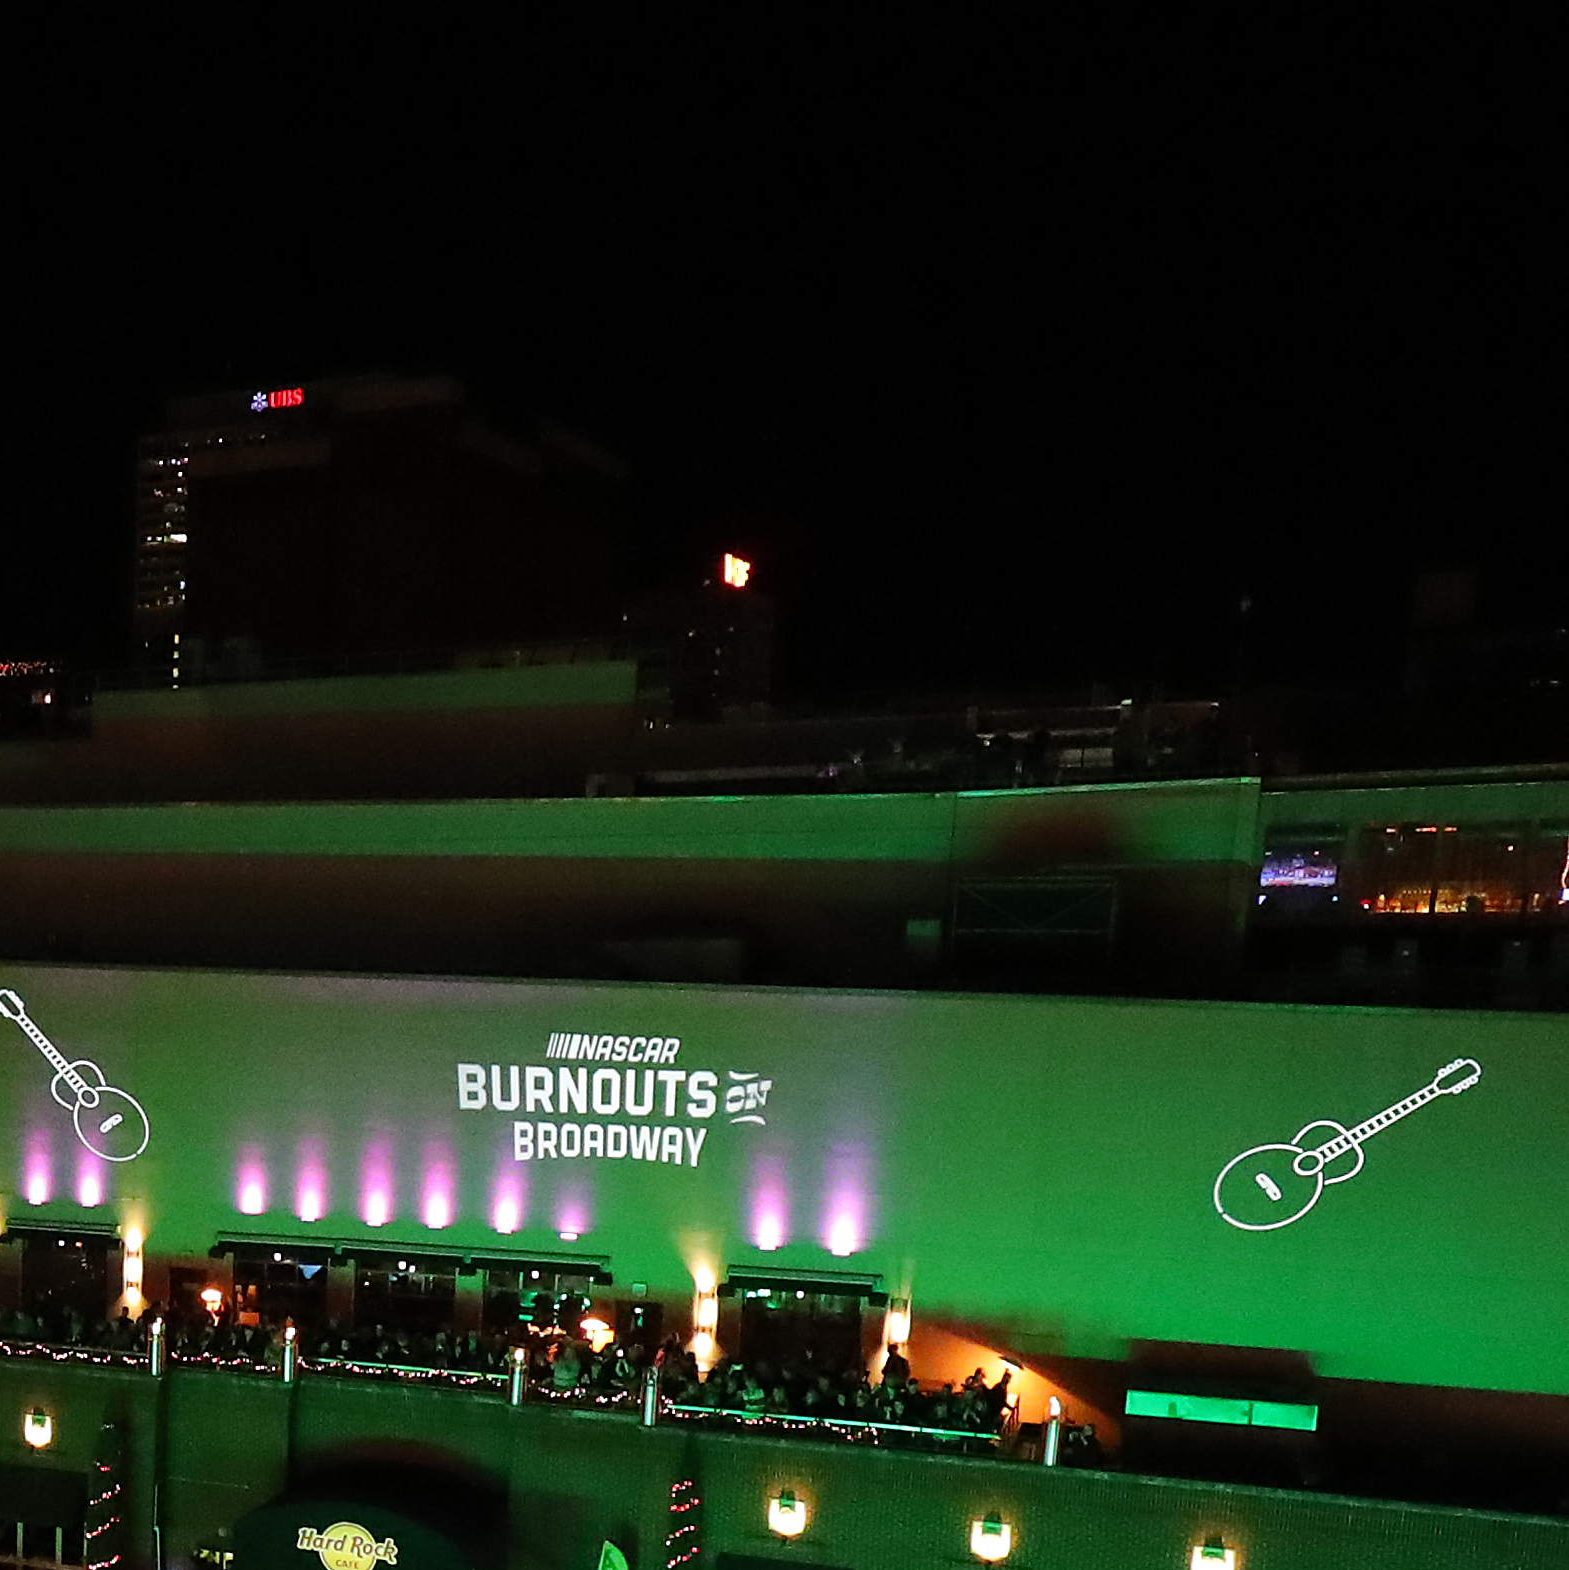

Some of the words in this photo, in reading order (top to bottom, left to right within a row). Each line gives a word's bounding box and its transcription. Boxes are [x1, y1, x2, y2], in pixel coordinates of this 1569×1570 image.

[269, 388, 304, 408] UBS
[578, 1034, 681, 1065] NASCAR
[457, 1063, 719, 1119] BURNOUTS
[725, 1079, 773, 1113] ON
[513, 1120, 708, 1168] BROADWAY
[297, 1527, 347, 1552] Hard
[350, 1535, 398, 1565] Rock
[336, 1559, 360, 1570] CAFE
